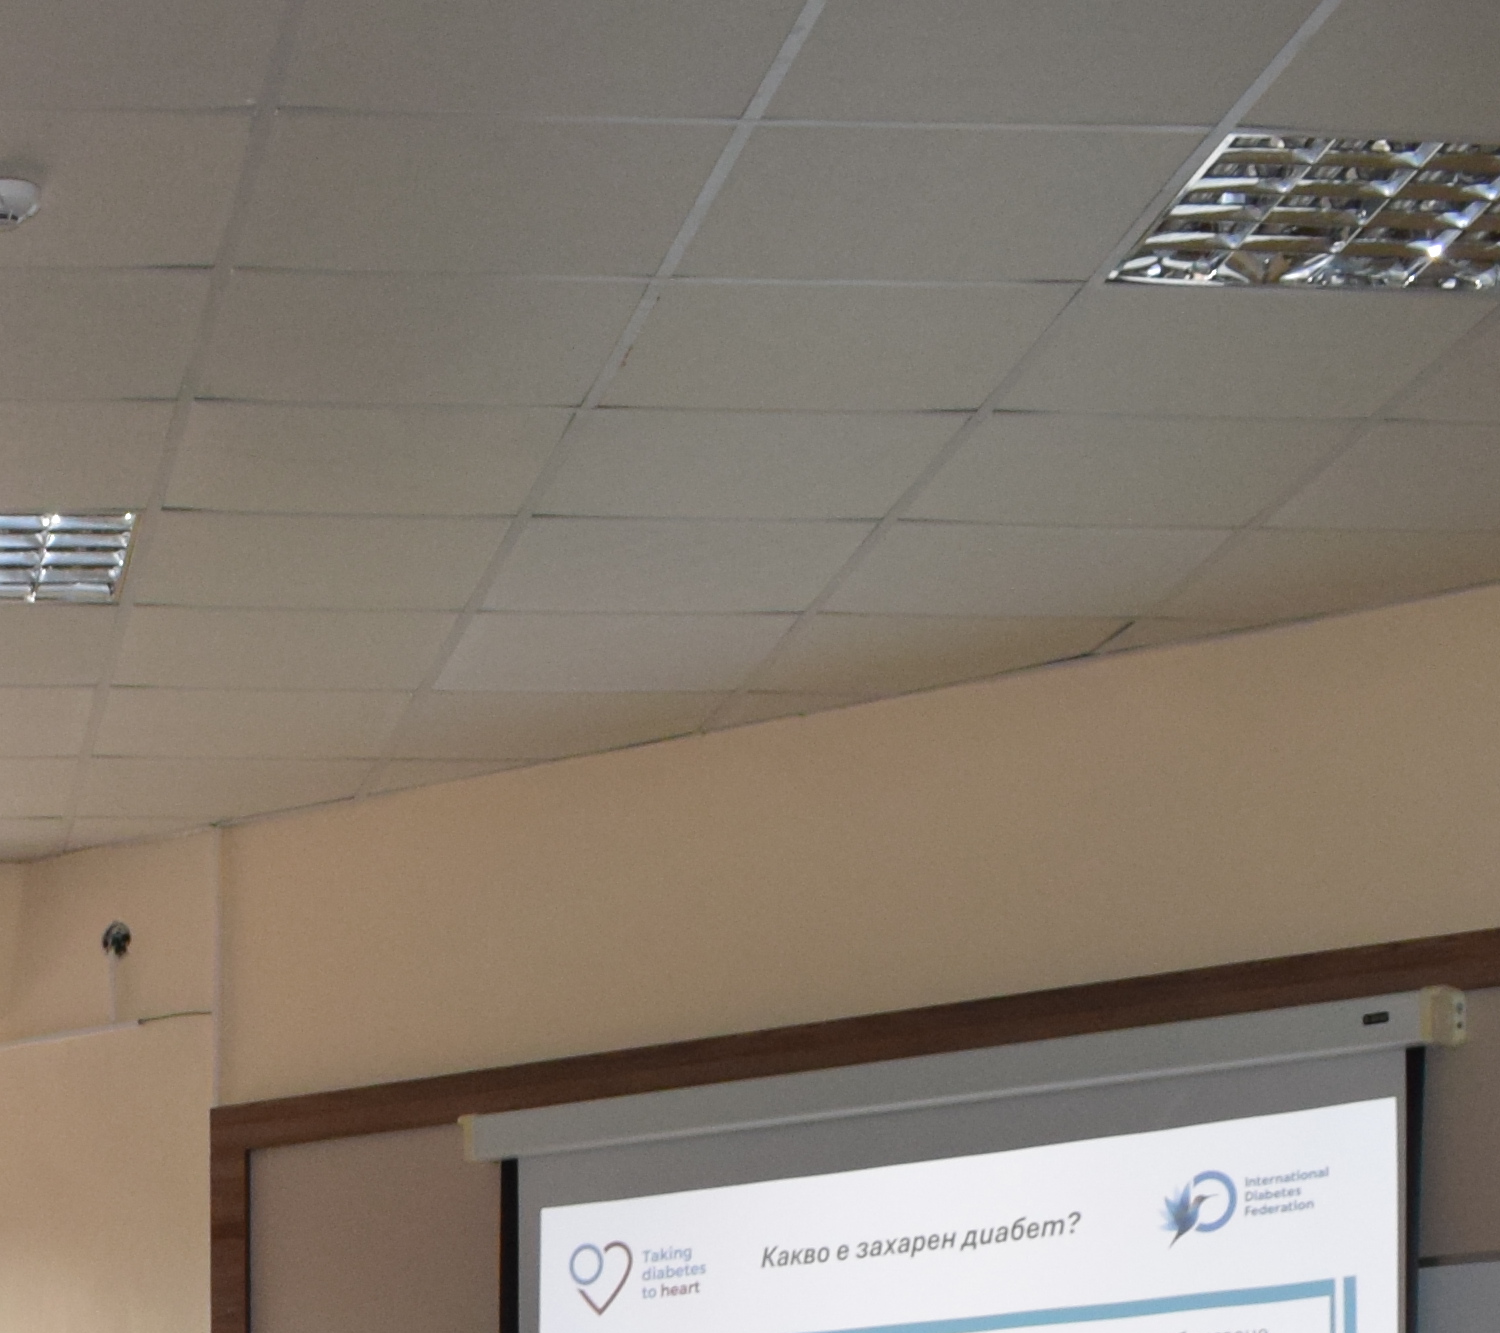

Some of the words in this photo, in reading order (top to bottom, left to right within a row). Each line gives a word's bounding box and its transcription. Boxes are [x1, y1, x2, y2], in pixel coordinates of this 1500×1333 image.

[1244, 1166, 1330, 1188] International
[1244, 1186, 1302, 1202] Diabetes
[1244, 1199, 1315, 1217] Federation
[761, 1246, 830, 1268] Какво
[836, 1245, 849, 1261] е
[856, 1231, 957, 1258] захарен
[960, 1211, 1082, 1251] диабет?
[642, 1246, 693, 1263] Taking
[641, 1262, 707, 1281] diabetes
[641, 1286, 657, 1299] to
[660, 1281, 700, 1298] heart
